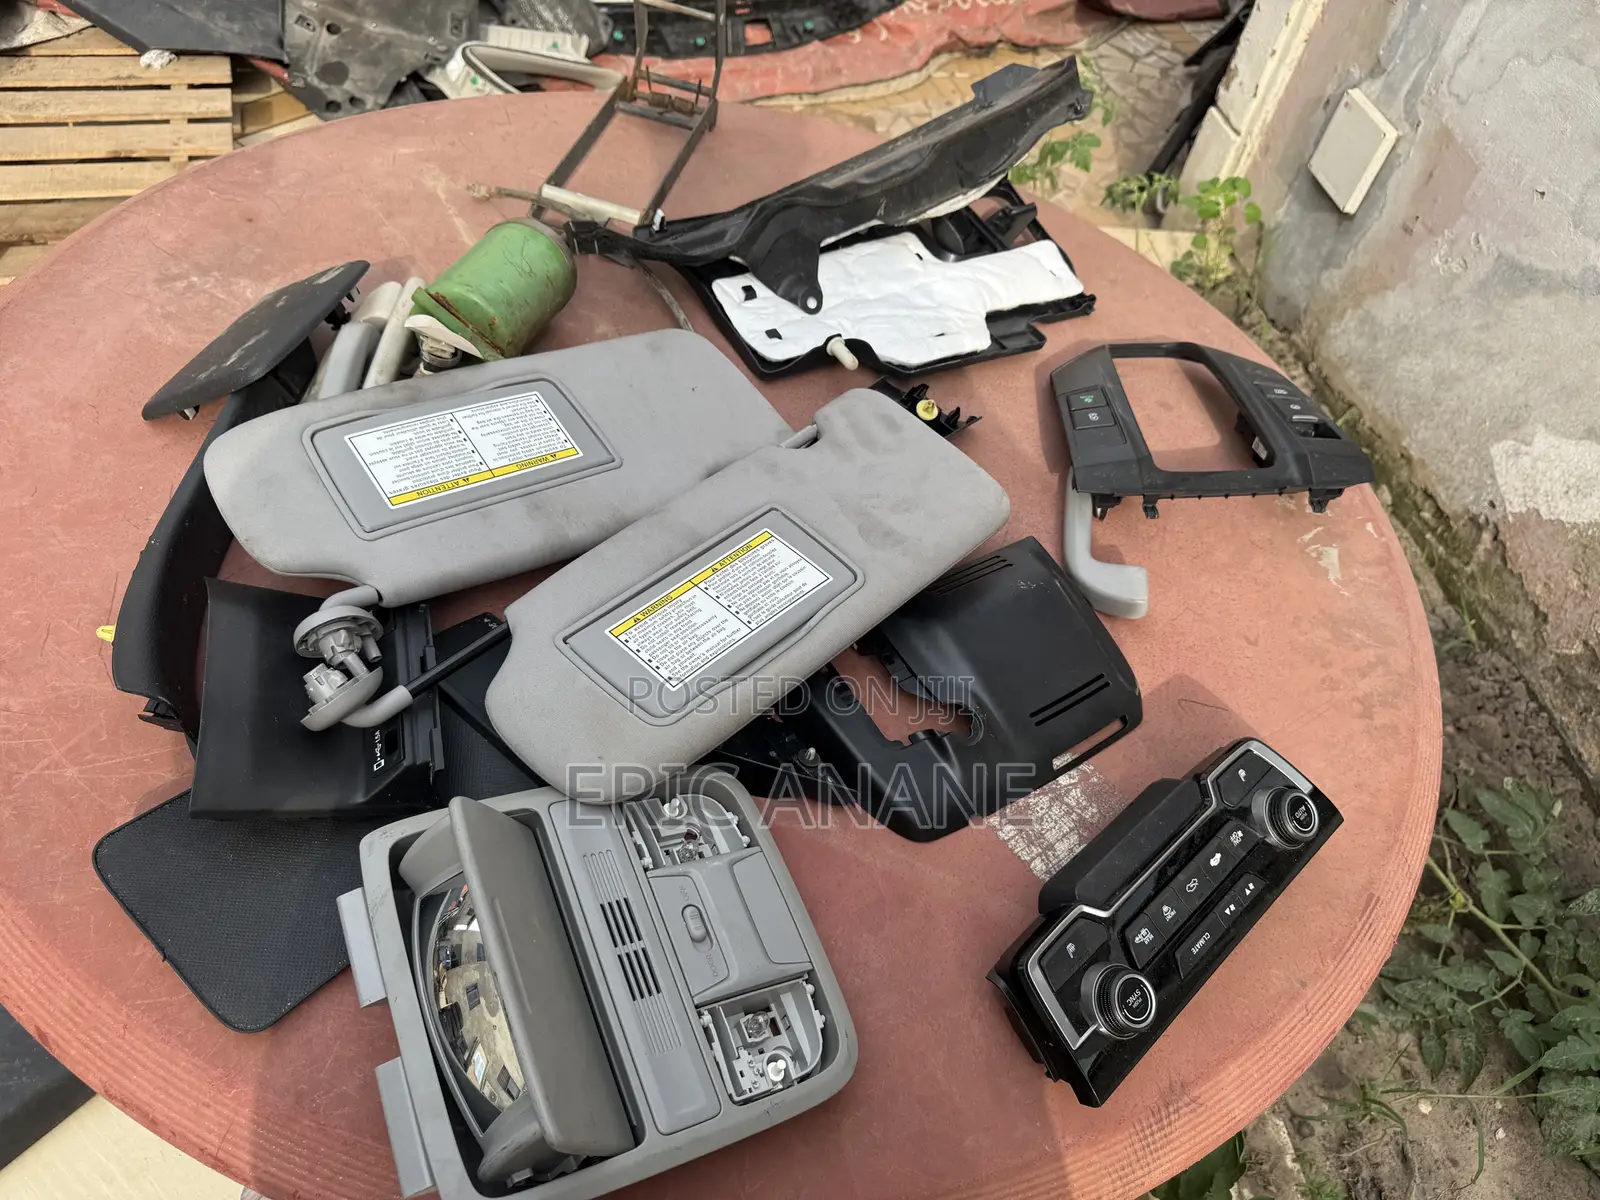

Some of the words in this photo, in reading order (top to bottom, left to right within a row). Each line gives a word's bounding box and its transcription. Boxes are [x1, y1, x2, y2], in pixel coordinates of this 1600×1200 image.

[515, 456, 549, 468] WARNING
[415, 480, 460, 496] ATTENTION
[718, 543, 753, 566] ATTENTION
[639, 594, 673, 617] WARNING
[1295, 805, 1306, 819] AUTO
[1229, 831, 1238, 843] OFF
[1165, 909, 1176, 921] FRONT
[1144, 934, 1154, 945] REAR
[1190, 932, 1210, 955] CLIMATE
[705, 953, 719, 977] DOOR
[1126, 988, 1141, 1006] SYNC
[1132, 997, 1142, 1008] PUSH
